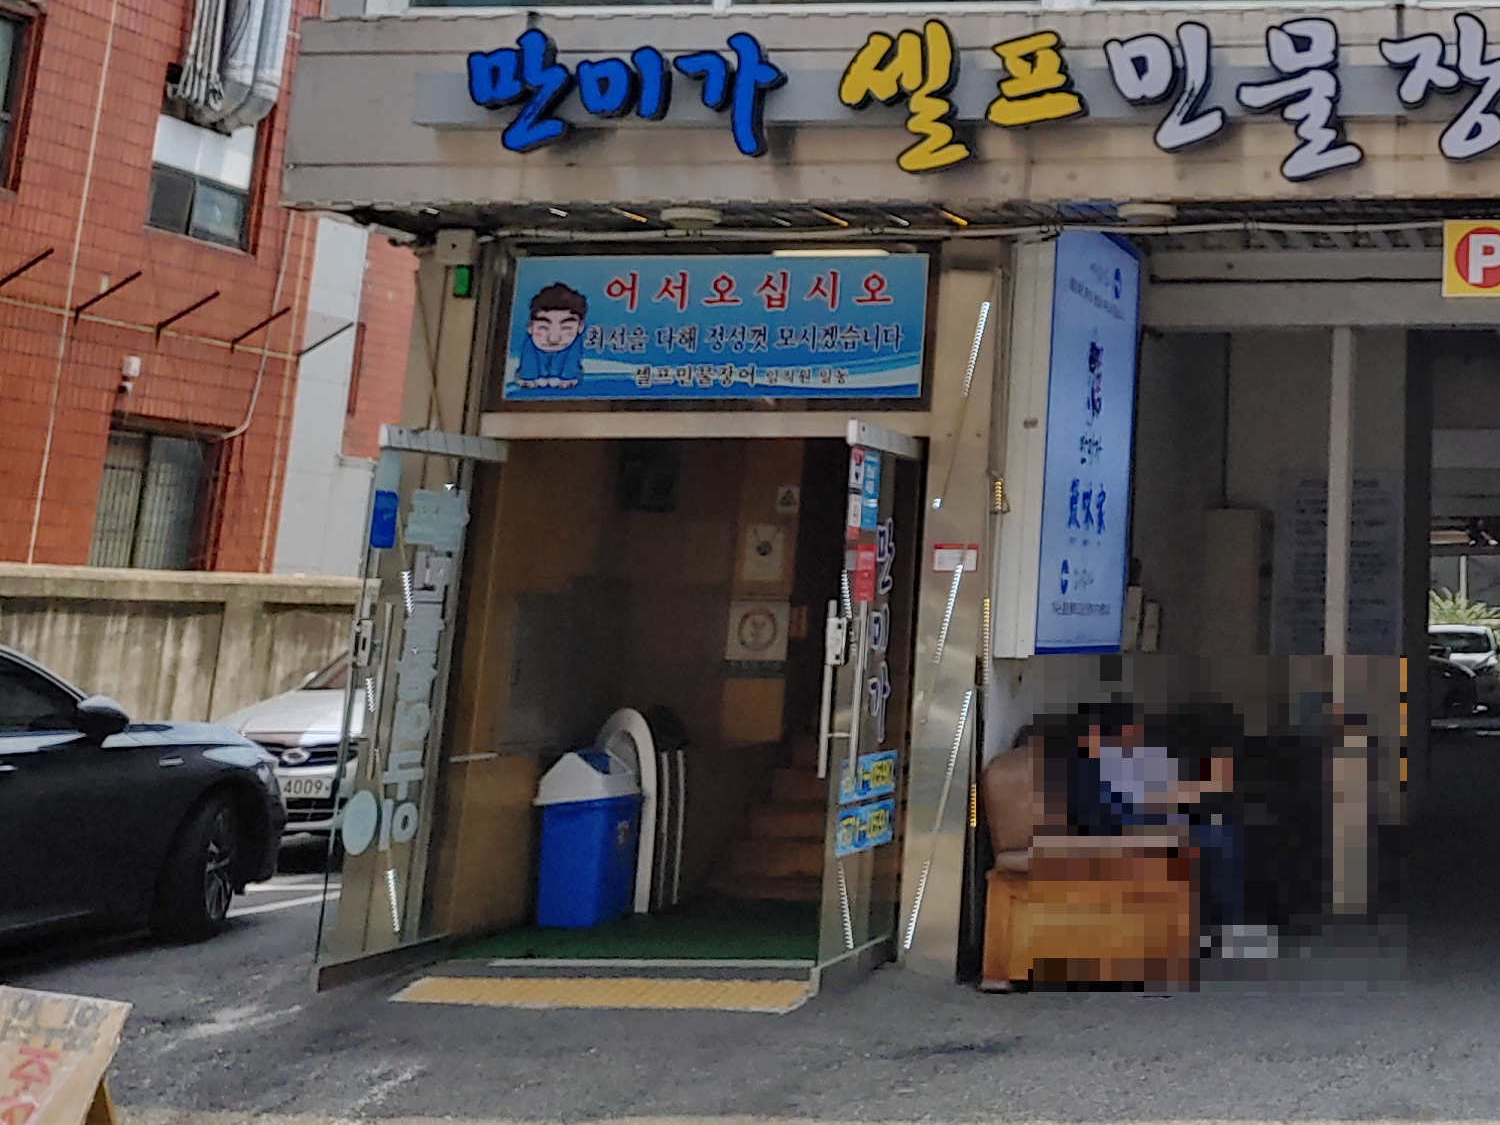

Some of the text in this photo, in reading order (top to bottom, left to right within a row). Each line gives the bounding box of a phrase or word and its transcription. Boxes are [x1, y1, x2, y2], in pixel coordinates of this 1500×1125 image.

[467, 28, 785, 156] 만미가
[838, 18, 1088, 173] 셀프
[604, 269, 895, 311] 어서오십시오
[656, 324, 699, 352] 다해
[775, 324, 903, 352] 모시겠습니다
